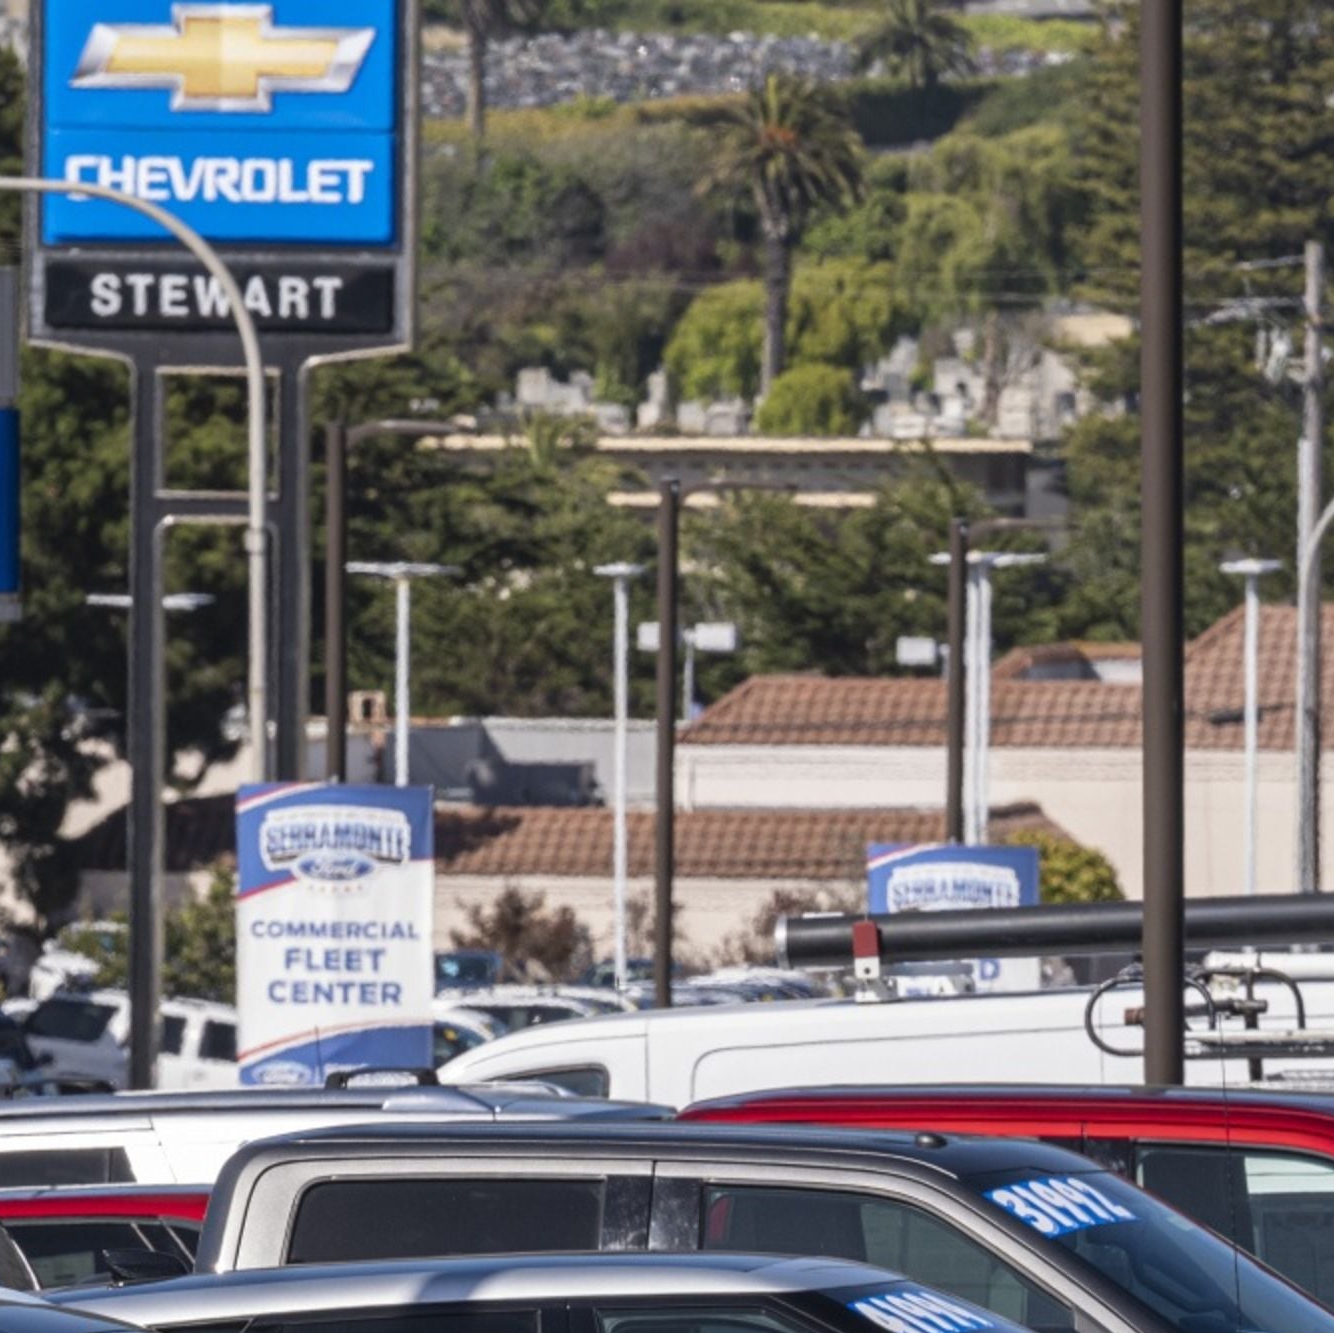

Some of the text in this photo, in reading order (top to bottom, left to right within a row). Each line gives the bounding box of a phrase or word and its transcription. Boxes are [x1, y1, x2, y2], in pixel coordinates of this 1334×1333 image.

[64, 155, 373, 204] CHEVROLET
[90, 272, 342, 319] STEWART
[266, 821, 405, 860] SERRAMONTE
[251, 920, 419, 940] COMMERCIAL
[285, 948, 386, 972] FLEET
[268, 981, 402, 1005] CENTER
[992, 1177, 1136, 1234] 31992
